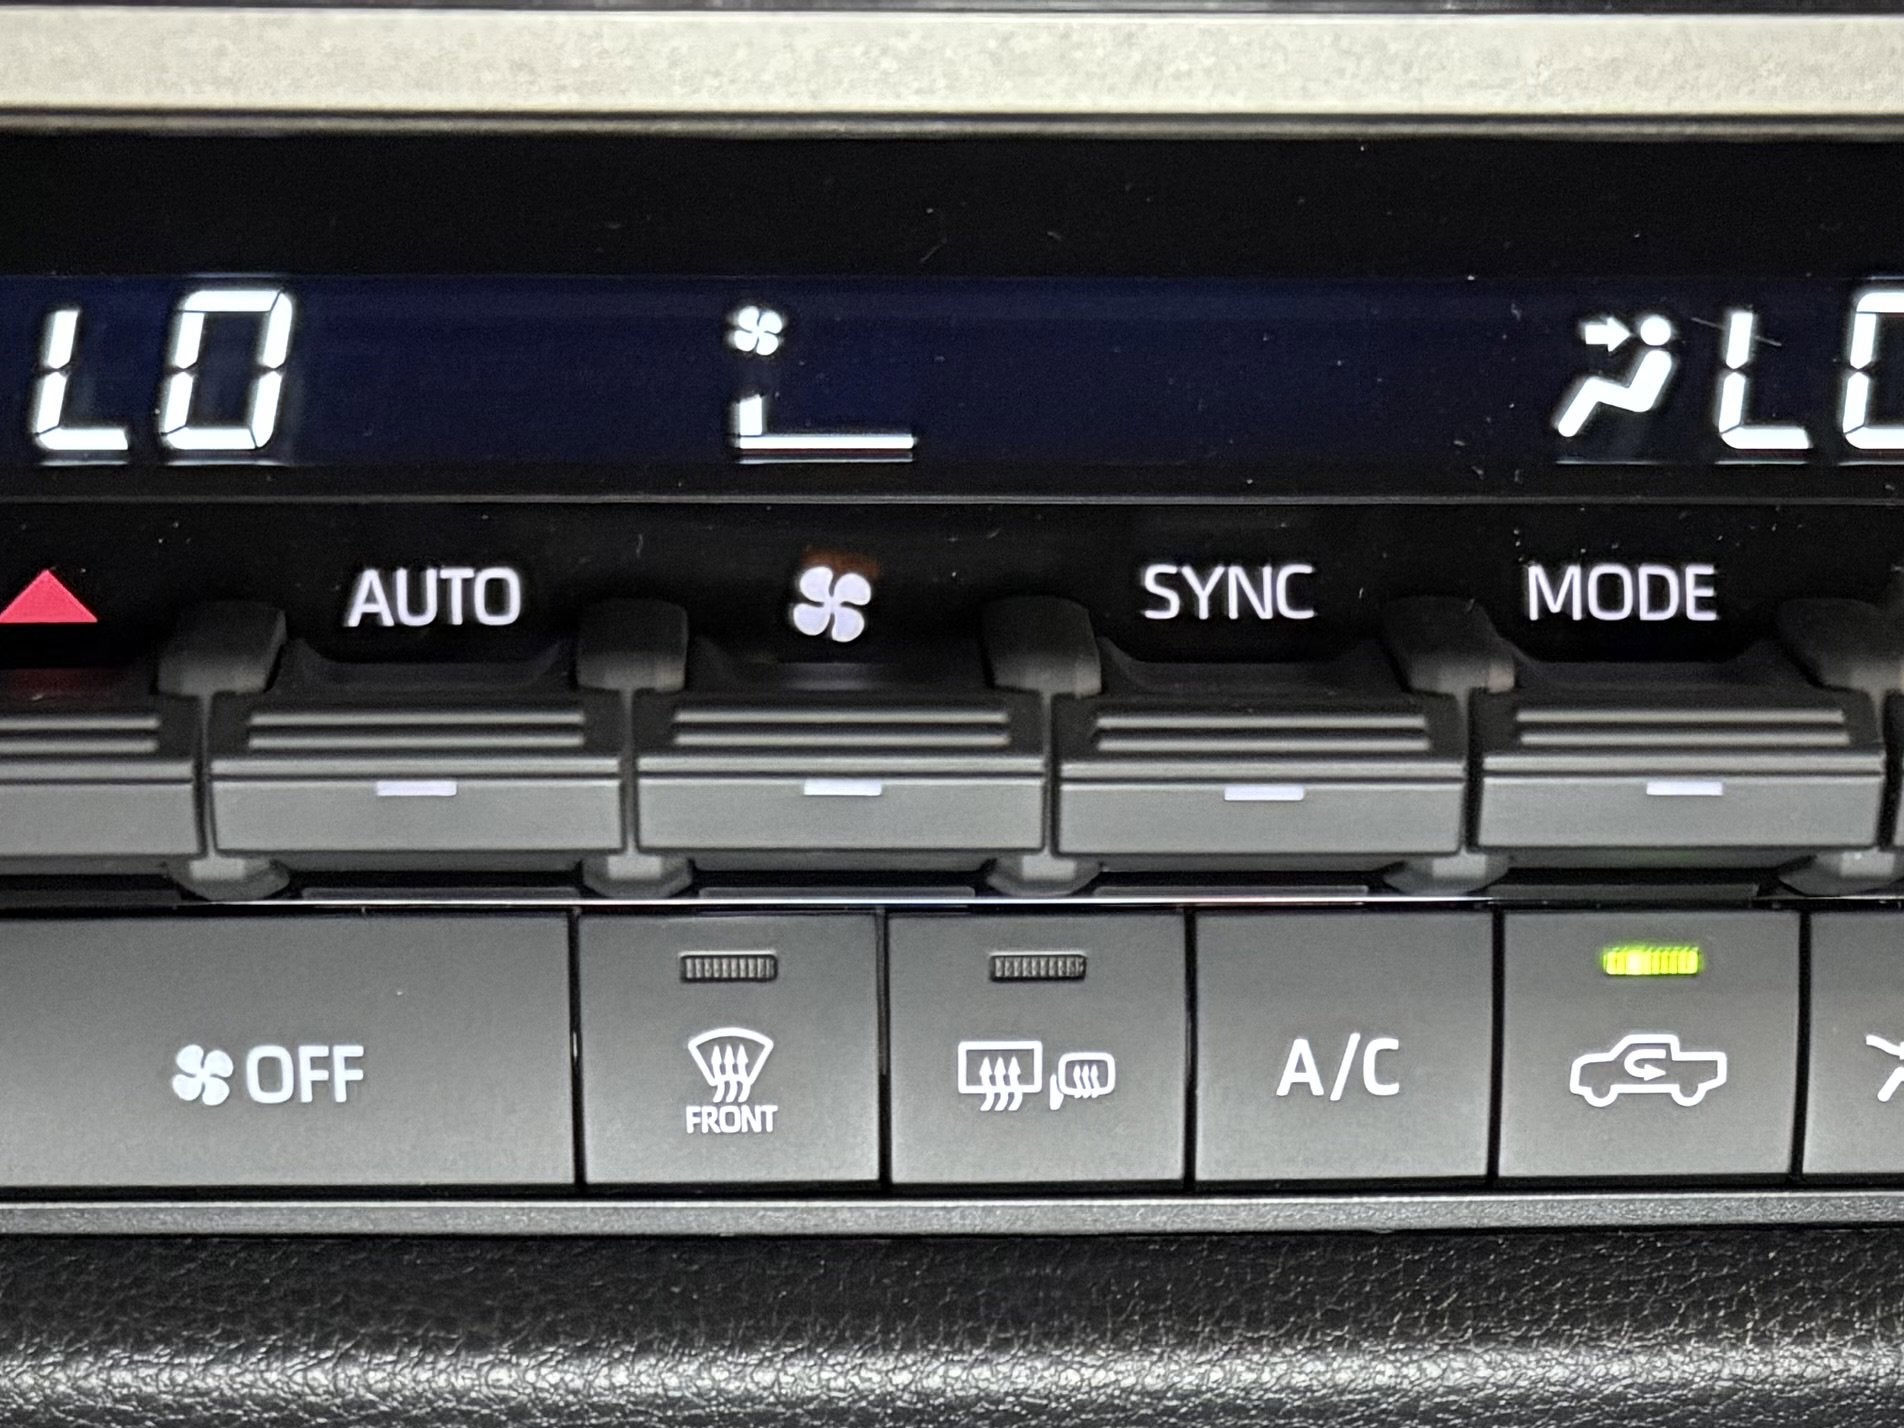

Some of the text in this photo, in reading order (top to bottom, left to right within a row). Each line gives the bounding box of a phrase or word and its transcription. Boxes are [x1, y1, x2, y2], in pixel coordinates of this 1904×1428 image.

[34, 288, 296, 453] LO
[345, 565, 523, 629] AUTO
[1141, 561, 1317, 622] SYNC
[1524, 561, 1719, 623] MODE
[245, 1043, 366, 1105] OFF
[1275, 1033, 1402, 1100] A/C
[683, 1102, 780, 1136] FRONT
